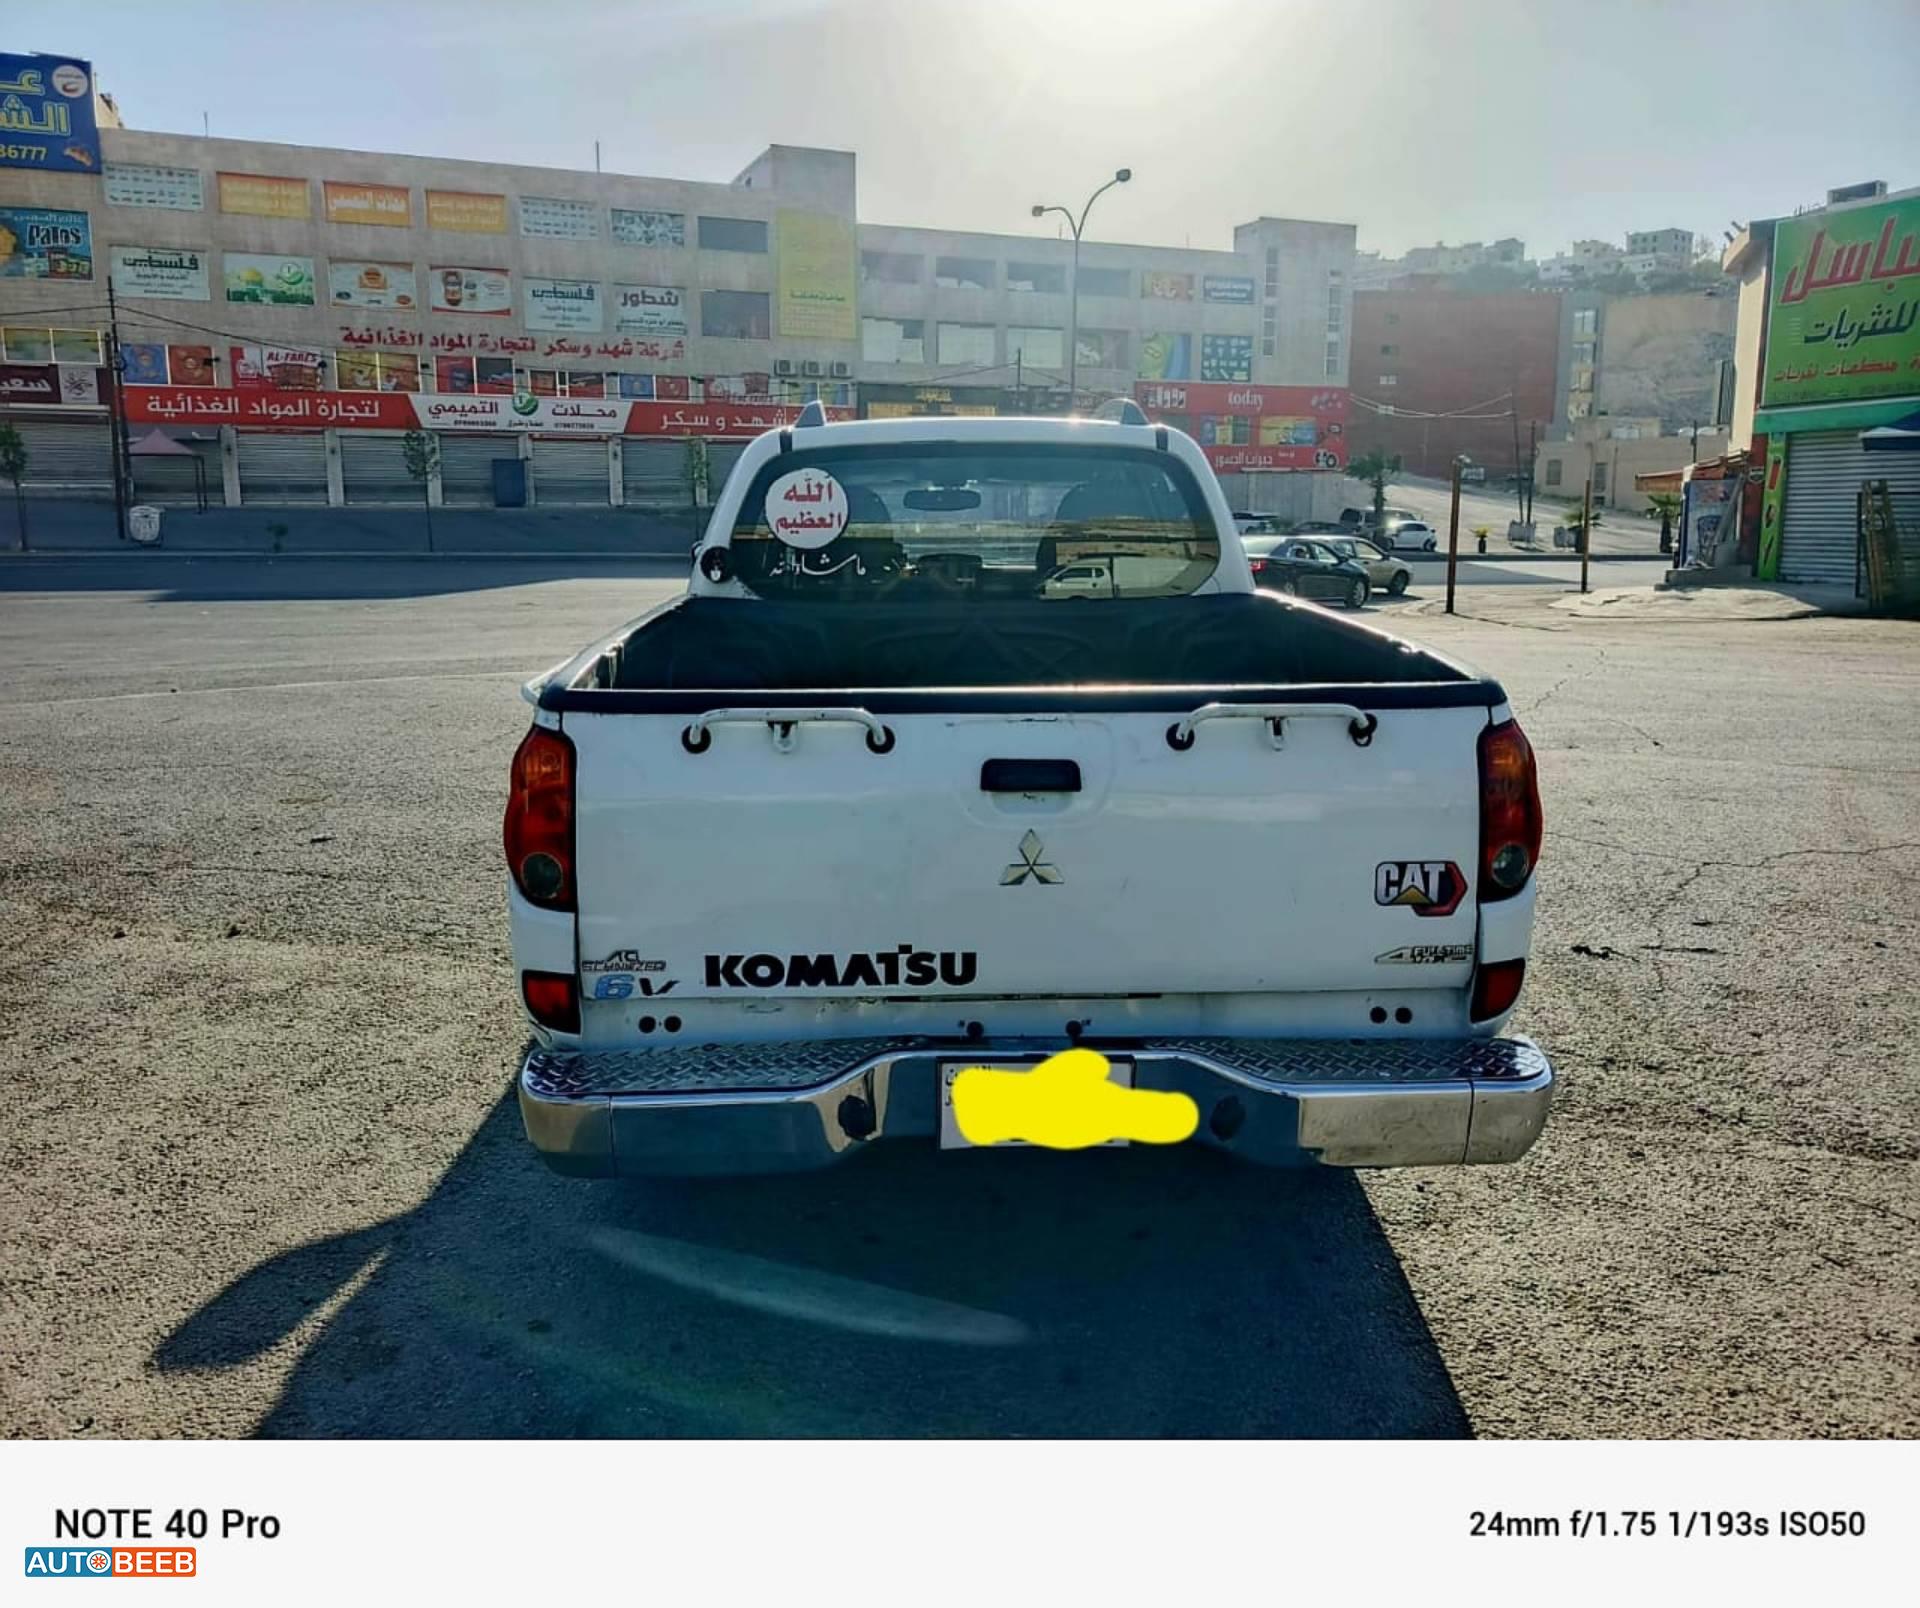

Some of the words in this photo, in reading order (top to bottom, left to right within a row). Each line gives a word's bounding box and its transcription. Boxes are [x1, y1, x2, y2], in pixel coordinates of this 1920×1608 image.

[147, 393, 240, 418] الغذائية
[248, 398, 310, 420] المواد
[317, 398, 381, 420] لتجارة
[428, 400, 499, 419] التميمي
[551, 404, 617, 419] محلات
[783, 477, 834, 502] الله
[776, 510, 842, 535] العظيم
[1376, 862, 1446, 906] CAT
[704, 944, 978, 987] KOMATSU
